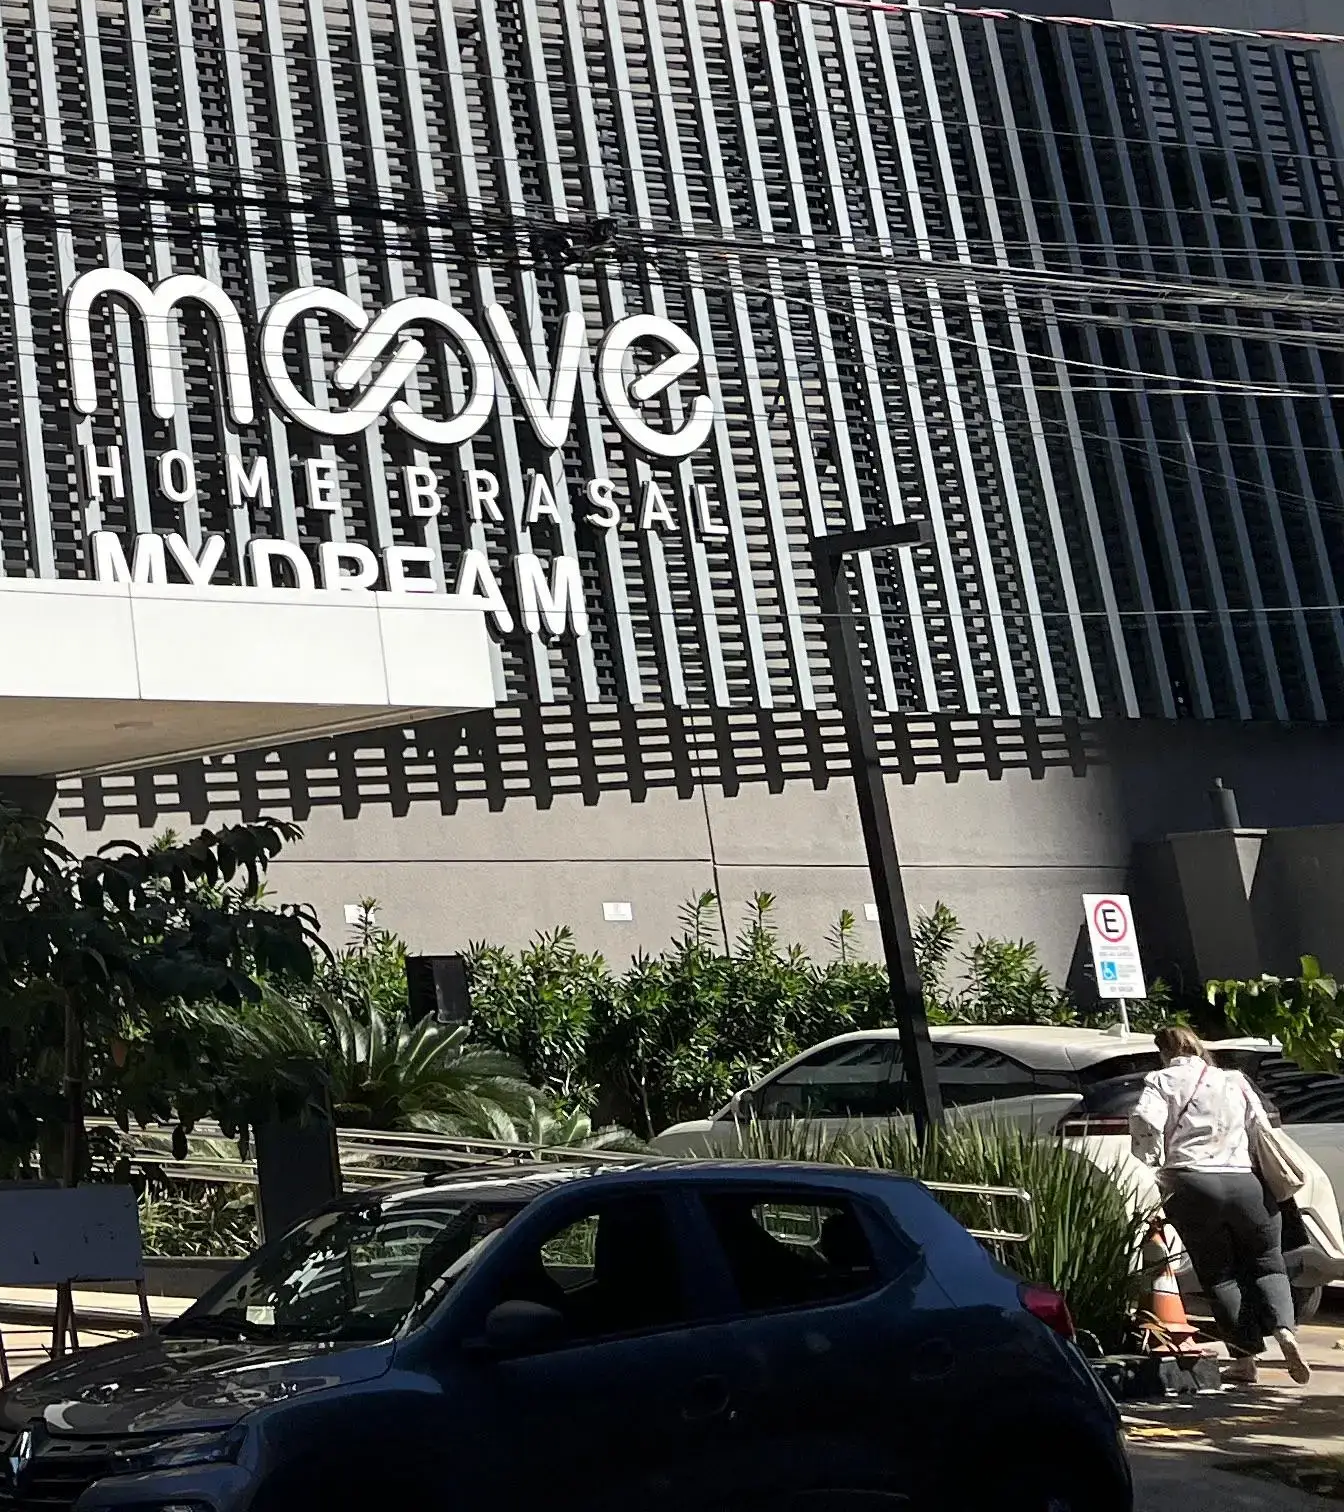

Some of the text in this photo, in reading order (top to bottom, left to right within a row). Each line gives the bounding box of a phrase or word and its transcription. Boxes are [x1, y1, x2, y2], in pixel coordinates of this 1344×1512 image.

[85, 443, 729, 536] HOME BRASAL
[93, 530, 589, 638] MY DREAM
[1102, 909, 1119, 933] E
